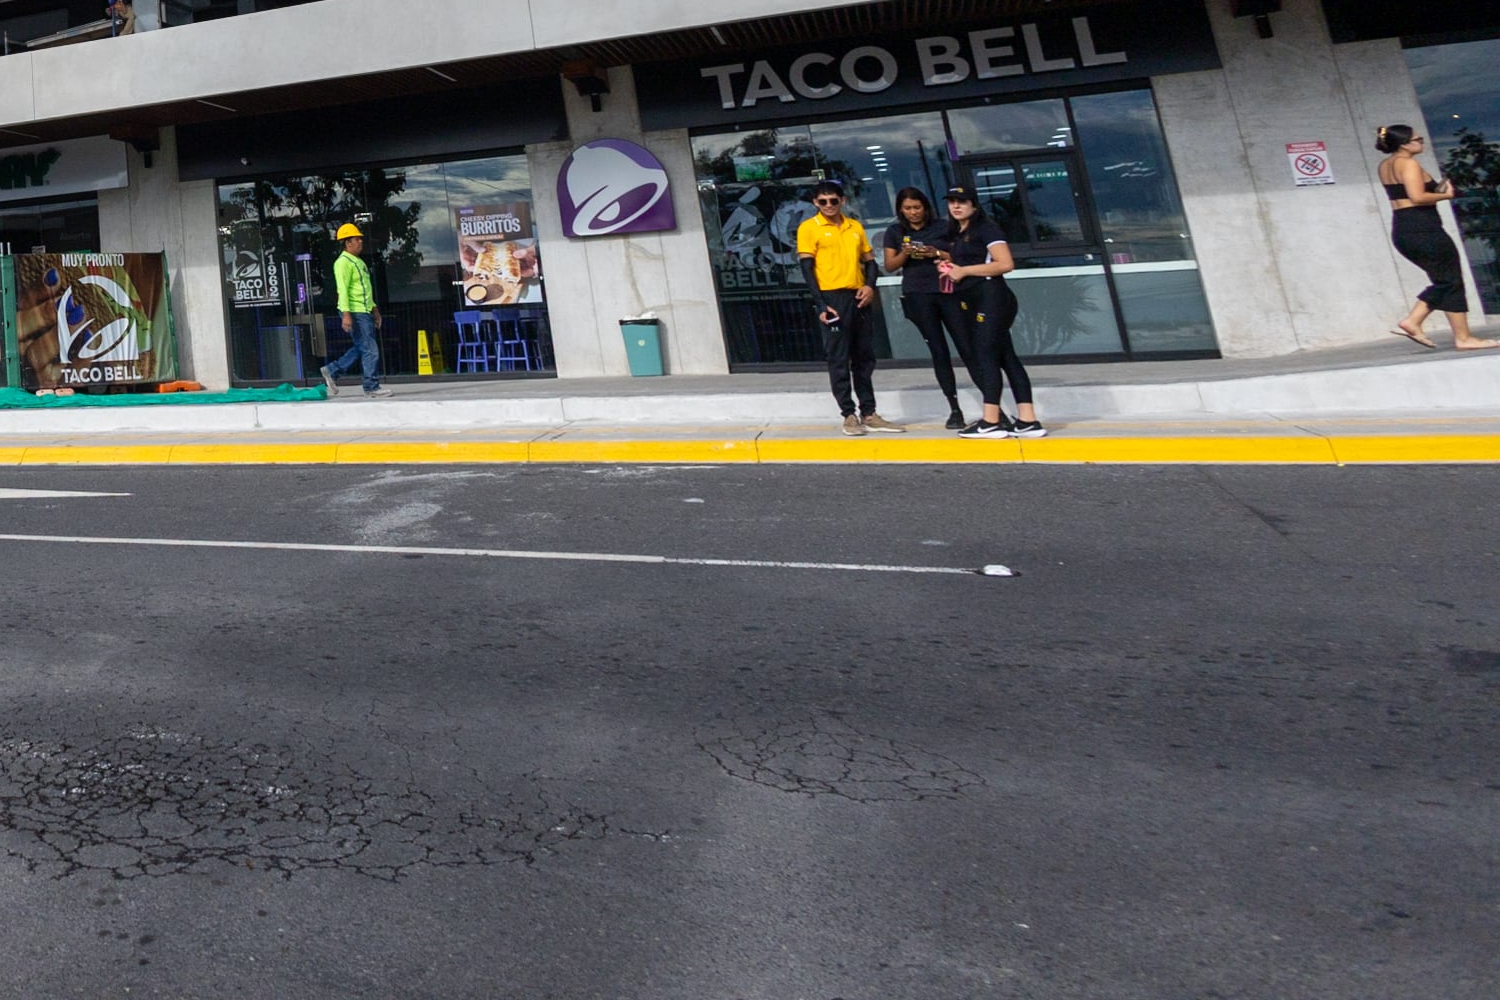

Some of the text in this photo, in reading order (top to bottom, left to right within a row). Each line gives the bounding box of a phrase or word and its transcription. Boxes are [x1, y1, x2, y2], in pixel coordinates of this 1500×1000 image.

[700, 16, 1128, 110] TACO BELL
[460, 215, 485, 223] CHEESY
[460, 218, 521, 236] BURRITOS
[62, 253, 125, 267] MUY PRONTO
[233, 279, 263, 290] TACO
[267, 254, 279, 297] 1962
[721, 268, 779, 288] BELL
[236, 289, 264, 300] BELL
[61, 365, 143, 383] TACO BELL
